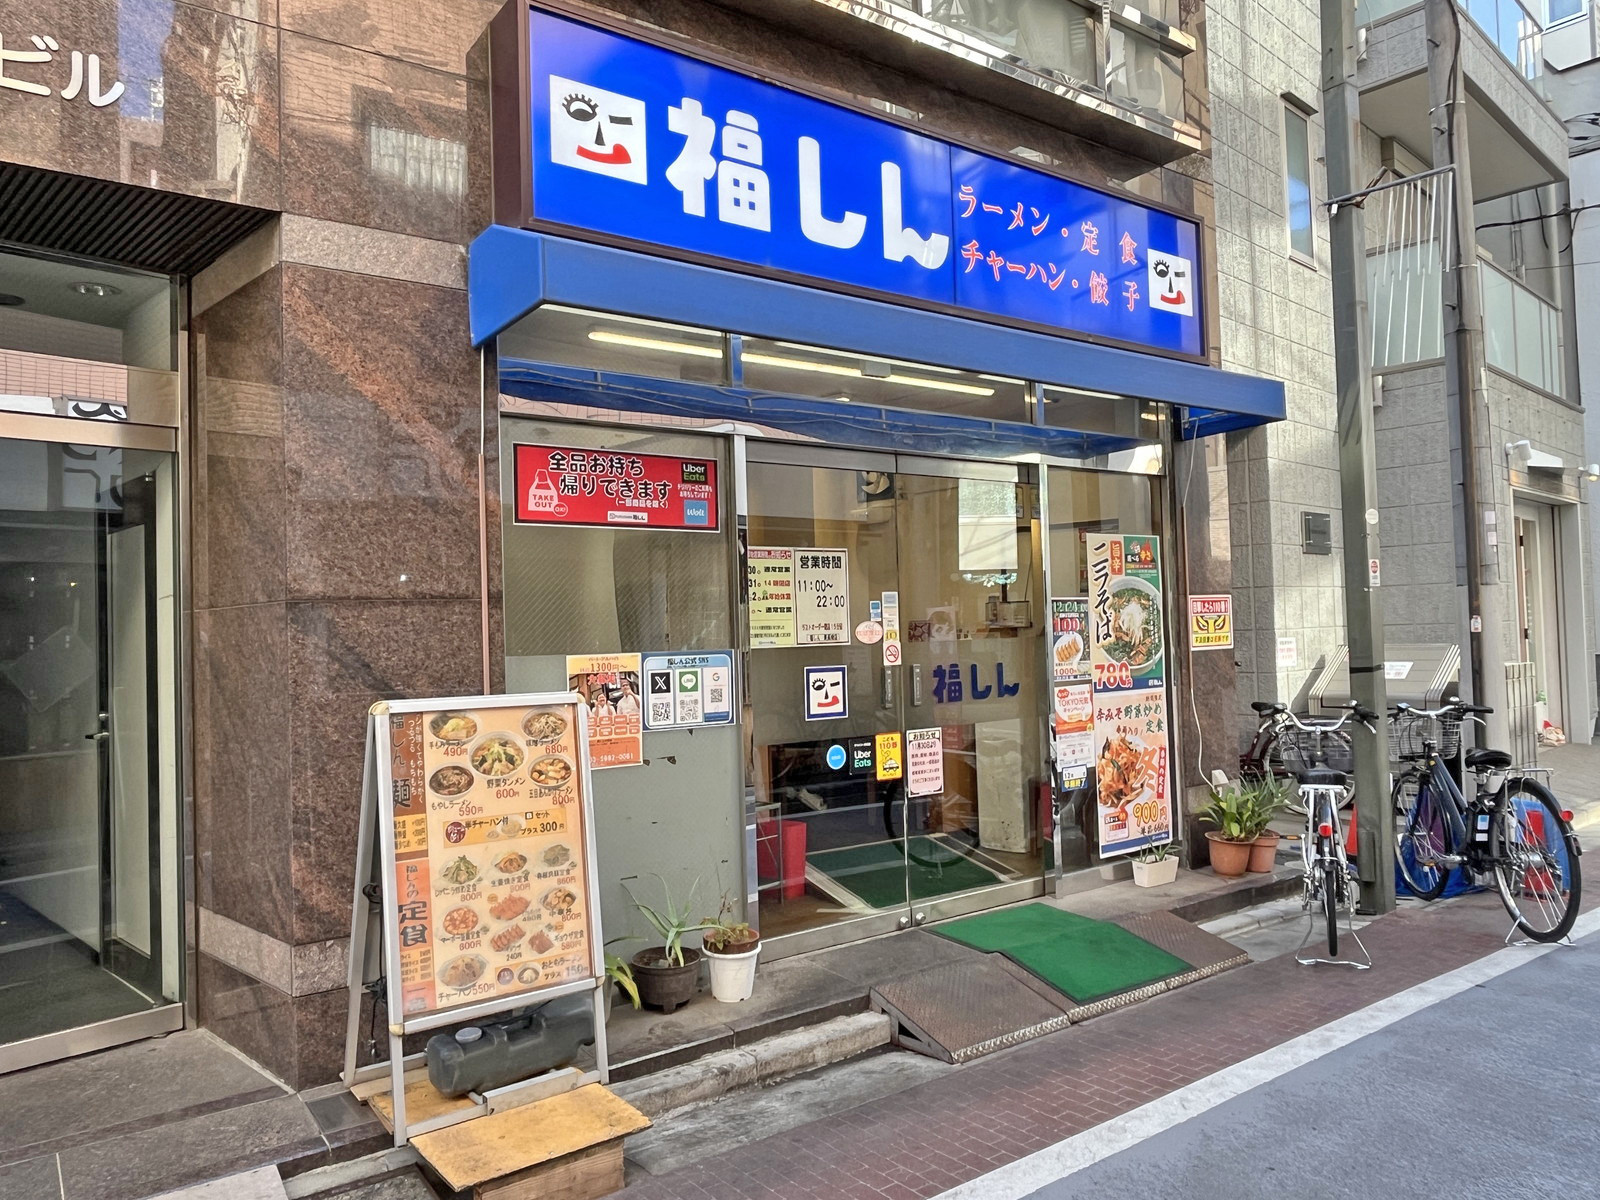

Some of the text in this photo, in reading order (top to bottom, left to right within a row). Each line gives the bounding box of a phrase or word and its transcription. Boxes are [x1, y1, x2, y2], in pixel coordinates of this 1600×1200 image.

[0, 34, 125, 107] ビル
[665, 97, 950, 270] 福しん
[548, 450, 644, 477] 全品お持ち
[683, 463, 705, 473] Uber
[683, 473, 705, 481] Eats
[559, 474, 672, 500] 帰りできます
[533, 494, 555, 502] TAKE
[534, 501, 553, 509] OUT
[687, 508, 705, 517] Wolt
[800, 555, 842, 569] 営業時間
[1111, 542, 1122, 574] 旨辛
[1091, 541, 1113, 645] ニラそば
[816, 595, 845, 607] 22:00
[932, 662, 1020, 704] 福しん
[913, 731, 937, 740] お知らせ
[443, 746, 468, 757] 490円
[545, 744, 569, 754] 680円
[854, 750, 872, 760] Uber
[854, 759, 872, 768] Eats
[496, 788, 520, 799] 600円
[431, 799, 472, 811] もやしラーメン
[458, 805, 484, 817] 590円
[1132, 800, 1168, 828] 900円
